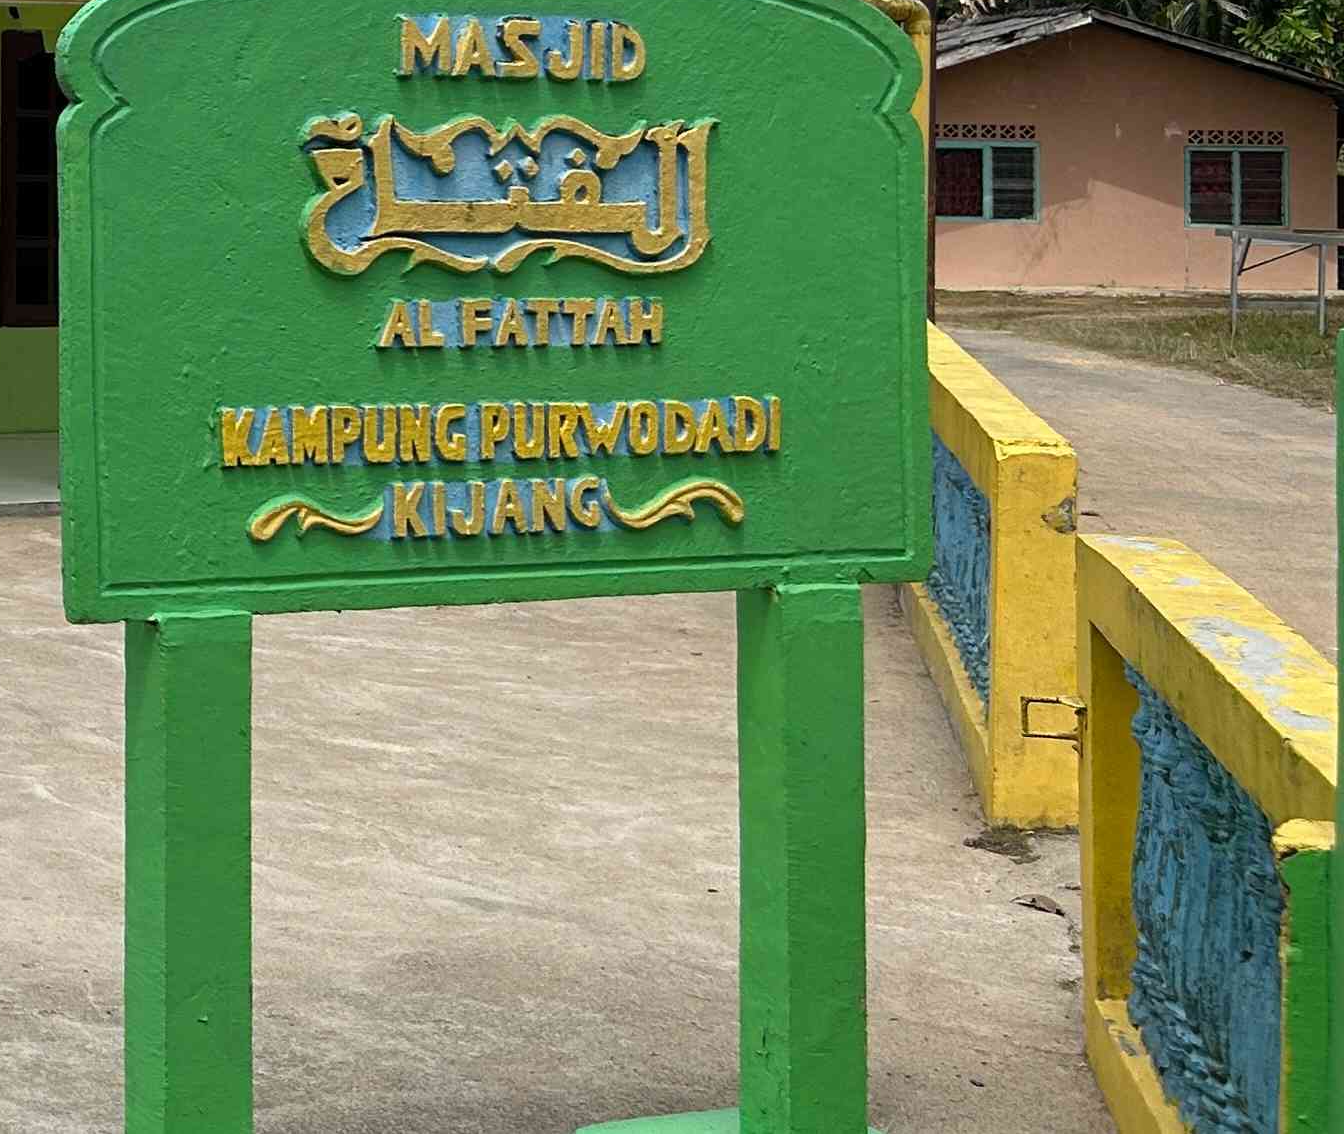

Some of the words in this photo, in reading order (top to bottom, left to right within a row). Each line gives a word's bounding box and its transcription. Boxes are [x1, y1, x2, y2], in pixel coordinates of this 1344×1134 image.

[397, 14, 647, 82] MASJID
[378, 298, 445, 347] AL
[459, 296, 663, 347] FATTAH
[220, 403, 467, 467] KAMPUNG
[480, 396, 782, 461] PURWODADI
[391, 476, 602, 538] KIJANG
